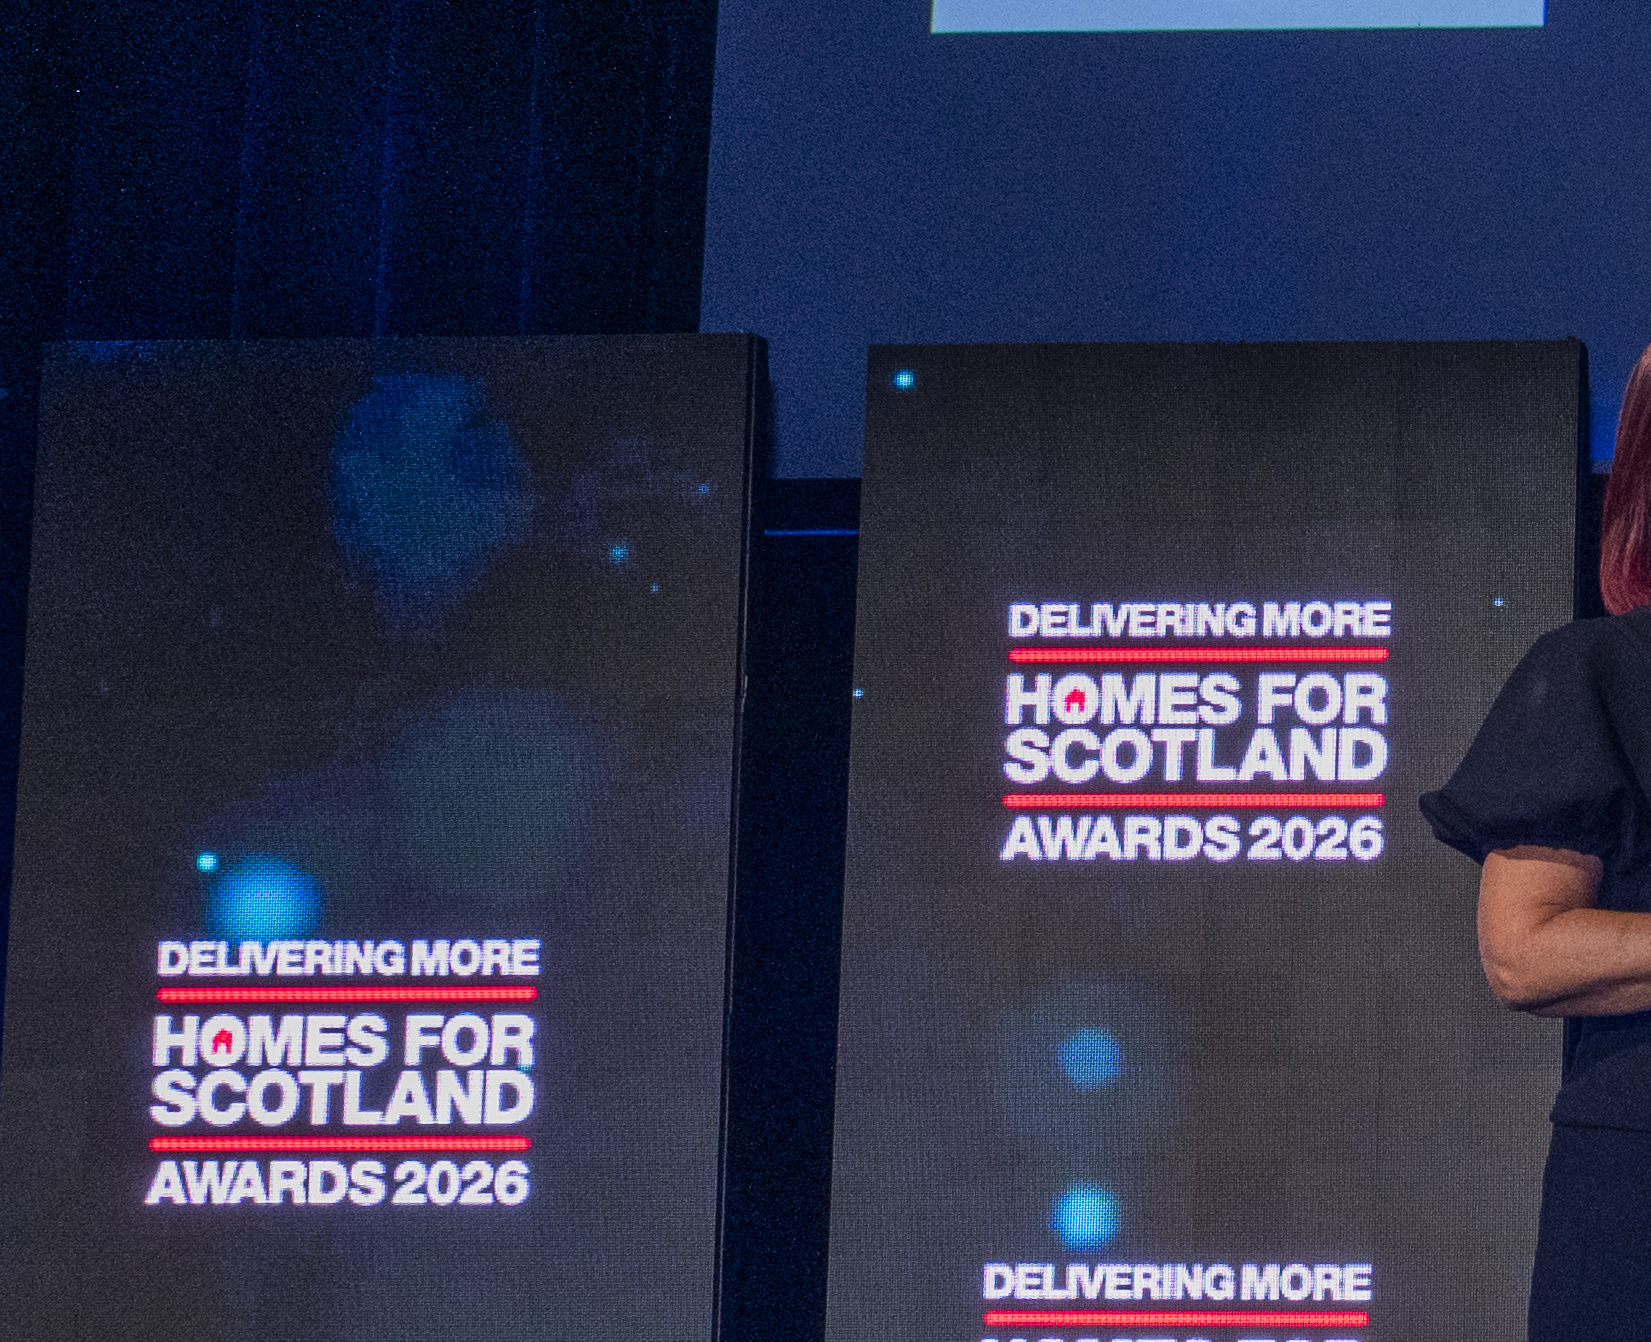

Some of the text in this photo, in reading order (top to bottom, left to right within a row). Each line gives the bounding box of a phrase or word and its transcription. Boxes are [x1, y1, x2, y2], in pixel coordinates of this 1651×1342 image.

[1008, 601, 1392, 638] DELIVERING MORE
[1005, 672, 1389, 726] HOMES FOR
[1003, 726, 1389, 784] SCOTLAND
[1000, 815, 1384, 862] AWARDS 2026
[157, 939, 542, 976] DELIVERING MORE
[153, 1012, 537, 1067] HOMES FOR
[149, 1068, 535, 1127] SCOTLAND
[144, 1159, 531, 1206] AWARDS 2026
[983, 1262, 1373, 1302] DELIVERING MORE
